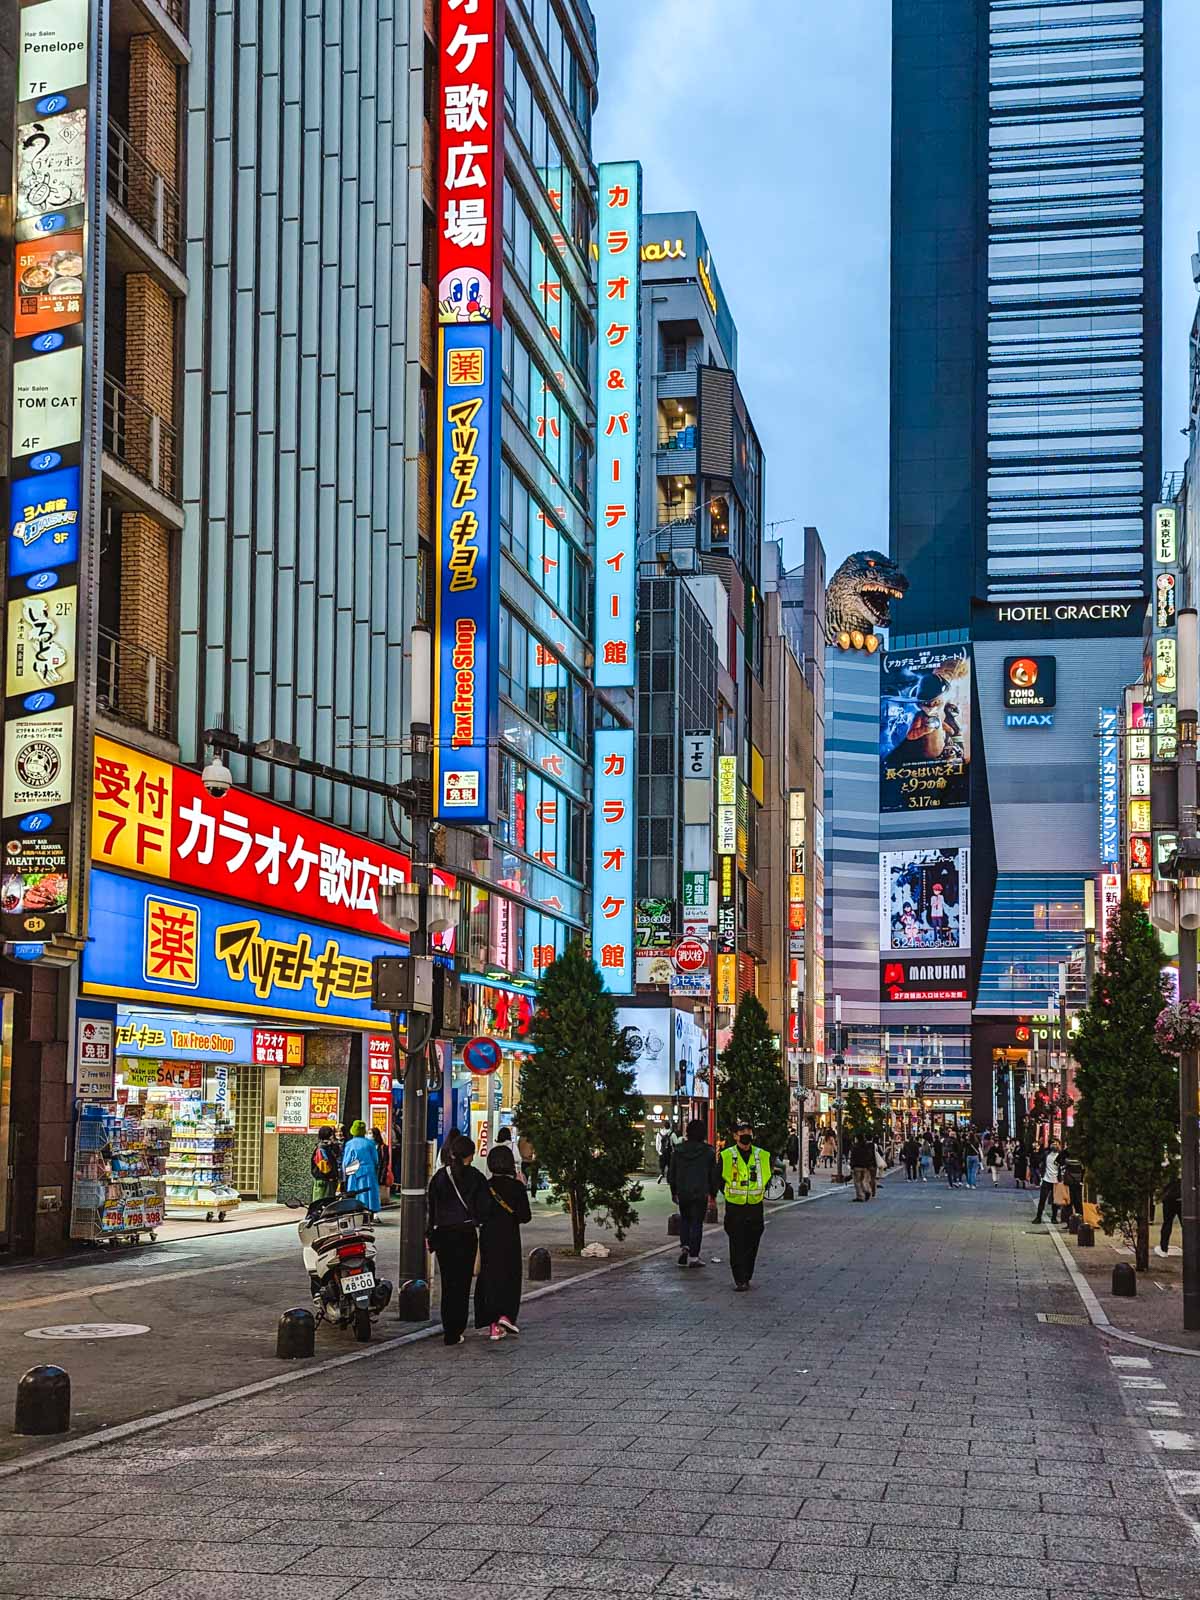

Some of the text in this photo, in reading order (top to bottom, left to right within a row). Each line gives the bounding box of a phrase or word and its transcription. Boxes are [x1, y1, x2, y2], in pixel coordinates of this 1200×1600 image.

[24, 41, 84, 53] Penelope
[29, 82, 47, 93] 7F
[47, 98, 58, 112] 6
[63, 127, 75, 140] 6F
[44, 217, 56, 230] 5
[20, 255, 35, 266] 5F
[40, 300, 80, 313] 一品鍋
[43, 336, 52, 349] 4
[450, 352, 481, 382] 薬
[18, 397, 78, 408] TOM CAT
[21, 438, 40, 448] 4F
[448, 398, 484, 592] マツモトキヨシ
[53, 532, 69, 544] 3F
[1161, 519, 1171, 558] 東京ビル
[36, 574, 48, 587] 2
[55, 602, 72, 616] 2F
[999, 604, 1131, 621] HOTEL GRACERY
[453, 618, 476, 669] Shop
[453, 670, 474, 713] Free
[1009, 690, 1034, 698] TOHO
[1006, 715, 1052, 726] IMAX
[453, 714, 474, 749] Tax
[691, 742, 704, 773] TFC
[886, 763, 965, 781] 長くつをはいたネコ
[26, 776, 51, 787] STAND
[94, 756, 169, 819] 受付
[900, 777, 948, 792] と9つの命
[450, 789, 474, 801] 免税
[1103, 762, 1117, 857] カラオケランド
[723, 810, 734, 849] CAPSULE
[98, 810, 164, 865] 7F
[601, 753, 626, 968] カラオケ館
[151, 907, 194, 978] 薬
[915, 940, 958, 948] ROADSHOW
[678, 950, 703, 961] 消火栓
[216, 920, 373, 1007] マツモトキヨシ
[909, 964, 967, 981] MARUHAN
[172, 1031, 234, 1053] Tax Free Shop
[256, 1033, 285, 1046] カラオケ
[370, 1040, 390, 1052] カラオケ
[85, 1044, 107, 1058] 免税
[256, 1049, 284, 1063] 歌広場
[288, 1044, 300, 1055] 入口
[157, 1068, 185, 1085] SALE
